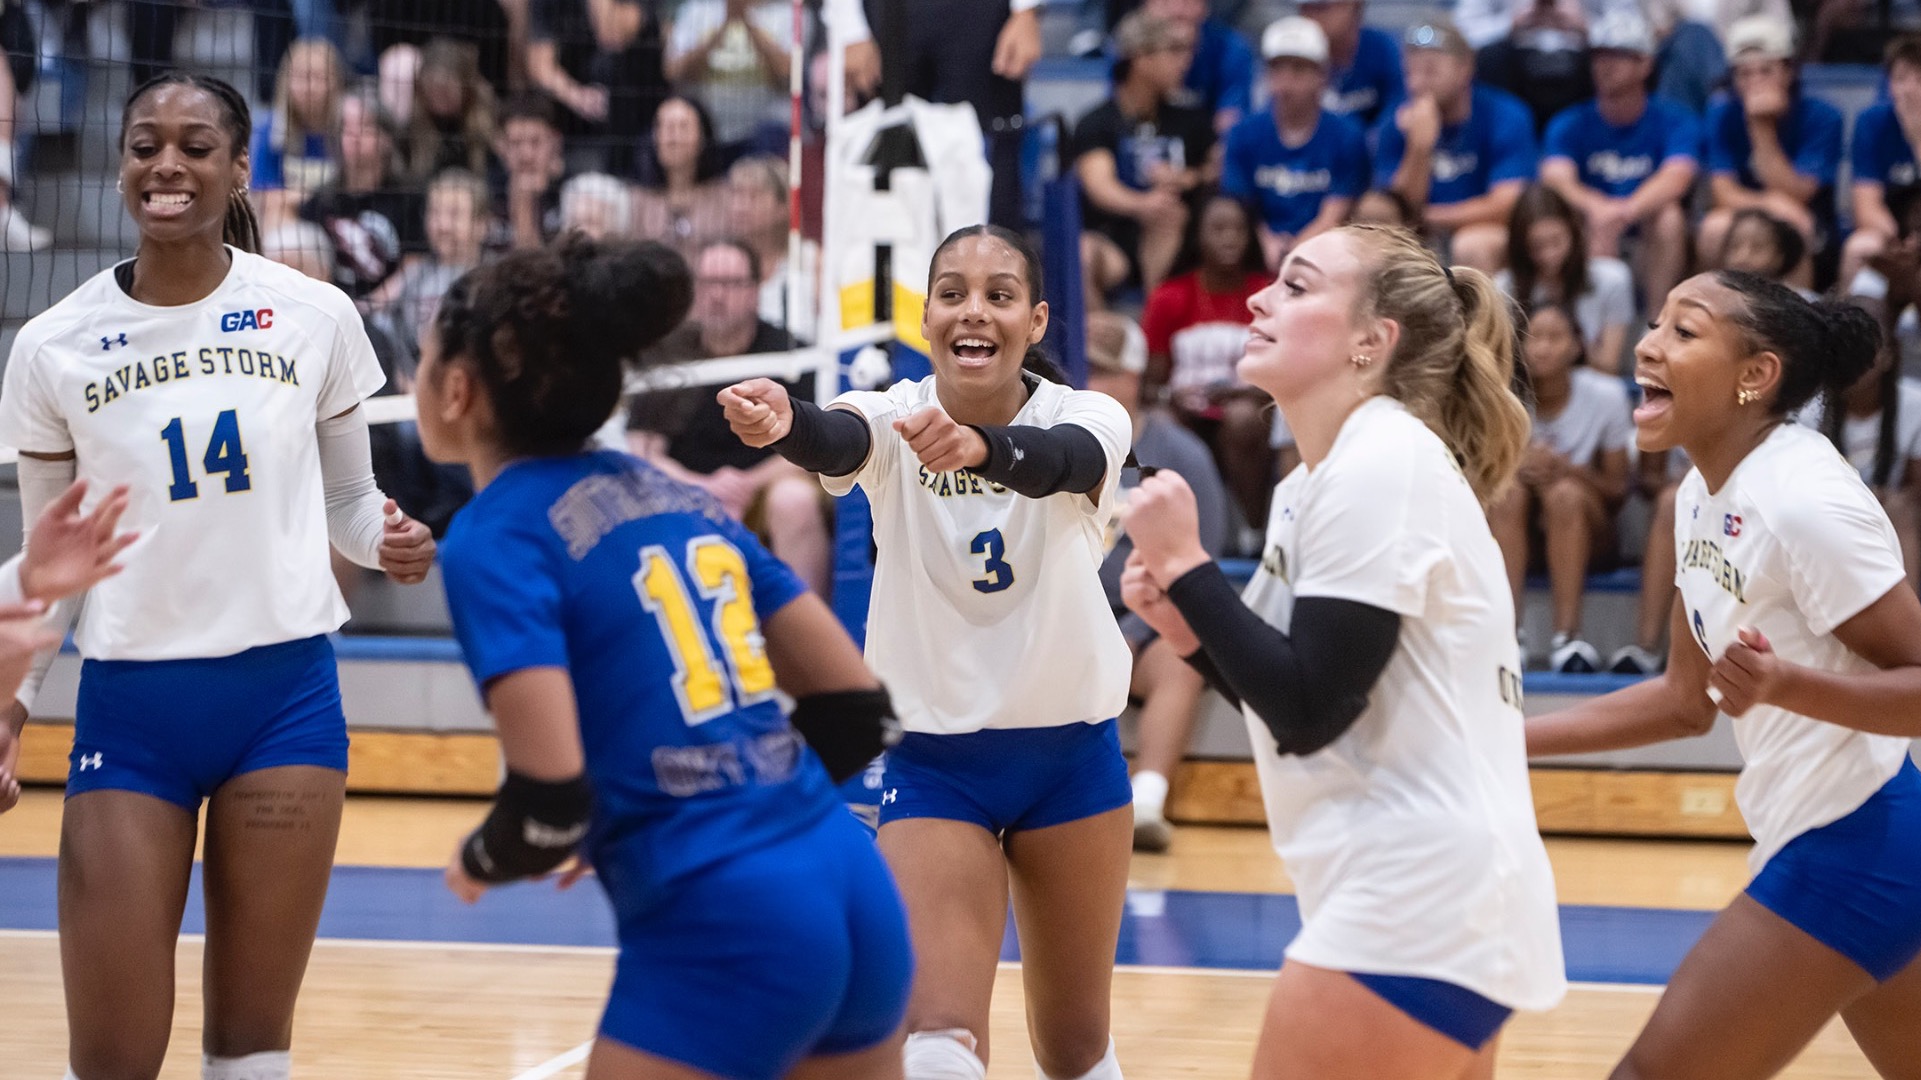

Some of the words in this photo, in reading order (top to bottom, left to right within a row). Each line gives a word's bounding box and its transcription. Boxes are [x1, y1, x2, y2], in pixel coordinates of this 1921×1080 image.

[221, 309, 273, 332] GAC
[84, 351, 190, 413] SAVAGE
[199, 347, 300, 387] STORM
[160, 408, 252, 502] 14
[970, 527, 1015, 594] 3
[631, 534, 797, 728] 12
